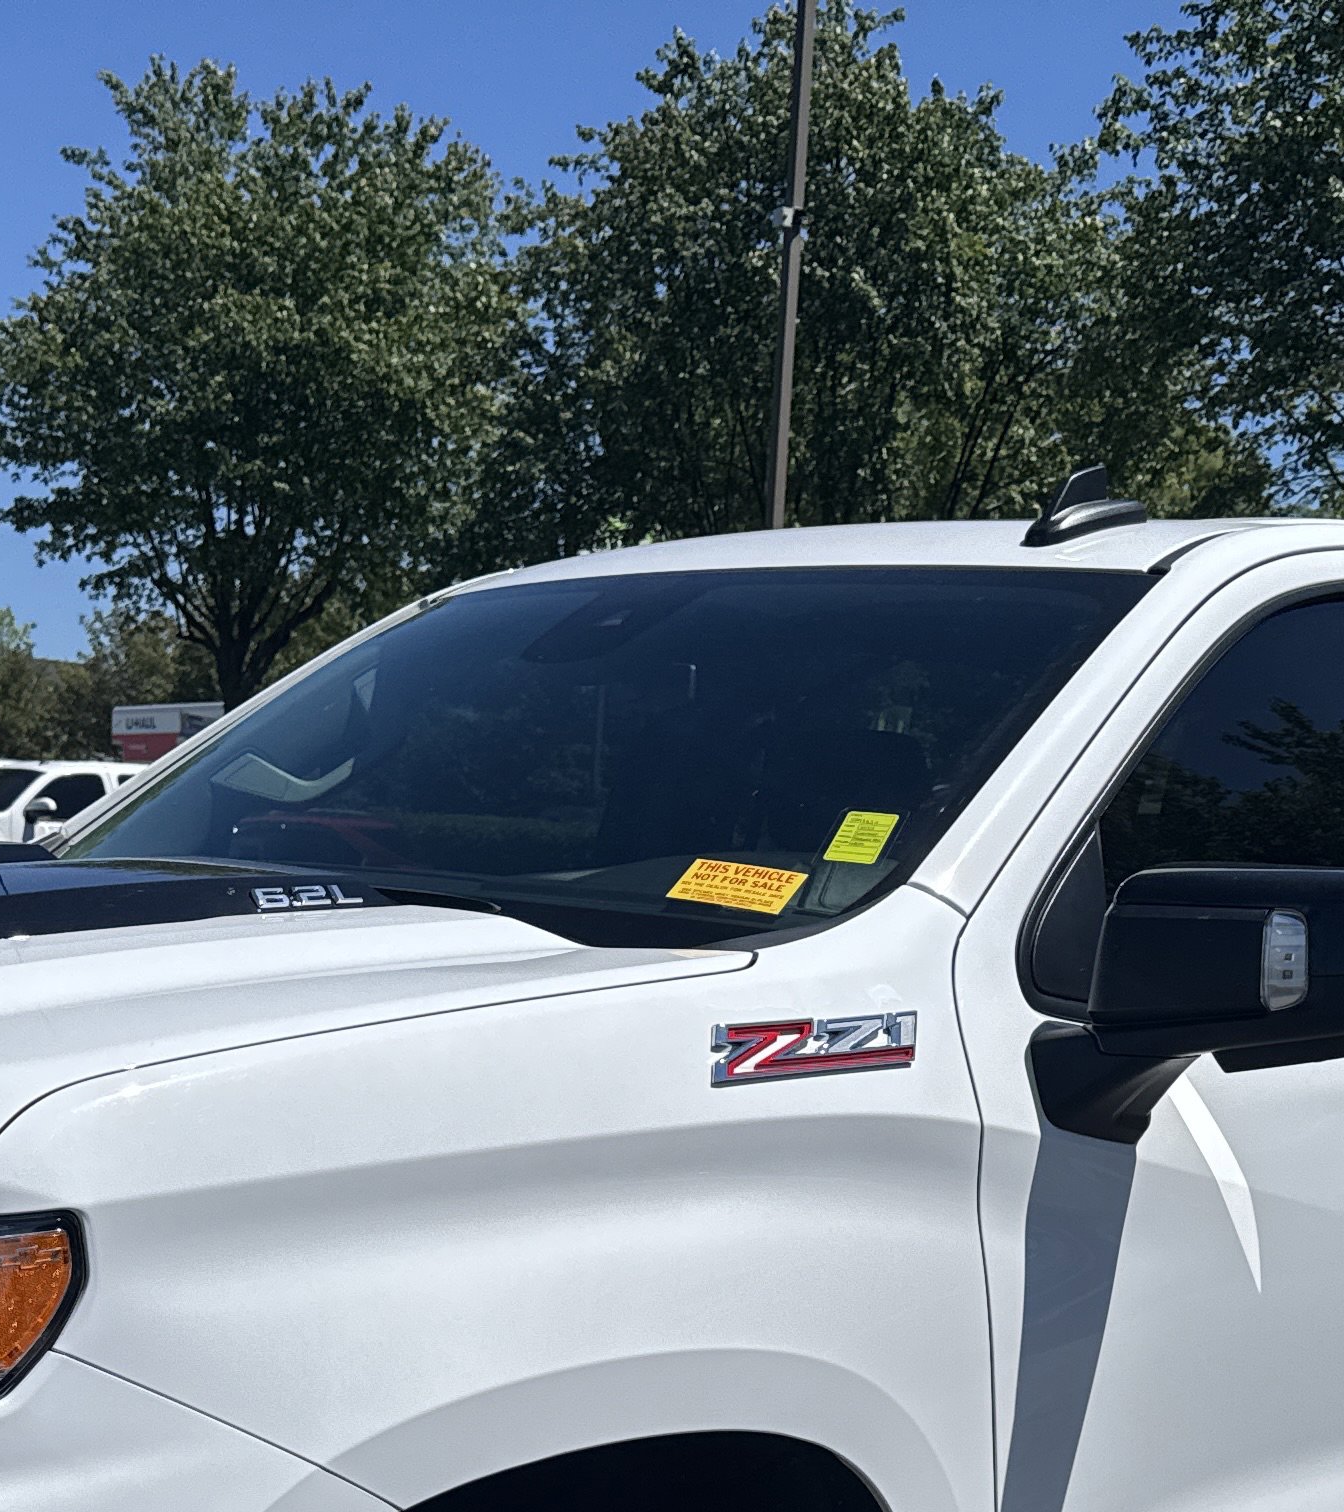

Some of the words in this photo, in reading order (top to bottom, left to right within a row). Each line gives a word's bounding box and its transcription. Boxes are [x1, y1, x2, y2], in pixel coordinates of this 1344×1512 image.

[691, 872, 719, 881] NOT
[720, 876, 747, 886] FOR
[750, 880, 786, 892] SALE
[697, 861, 731, 874] THIS
[735, 865, 798, 884] VEHICLE
[711, 1010, 917, 1088] Z71
